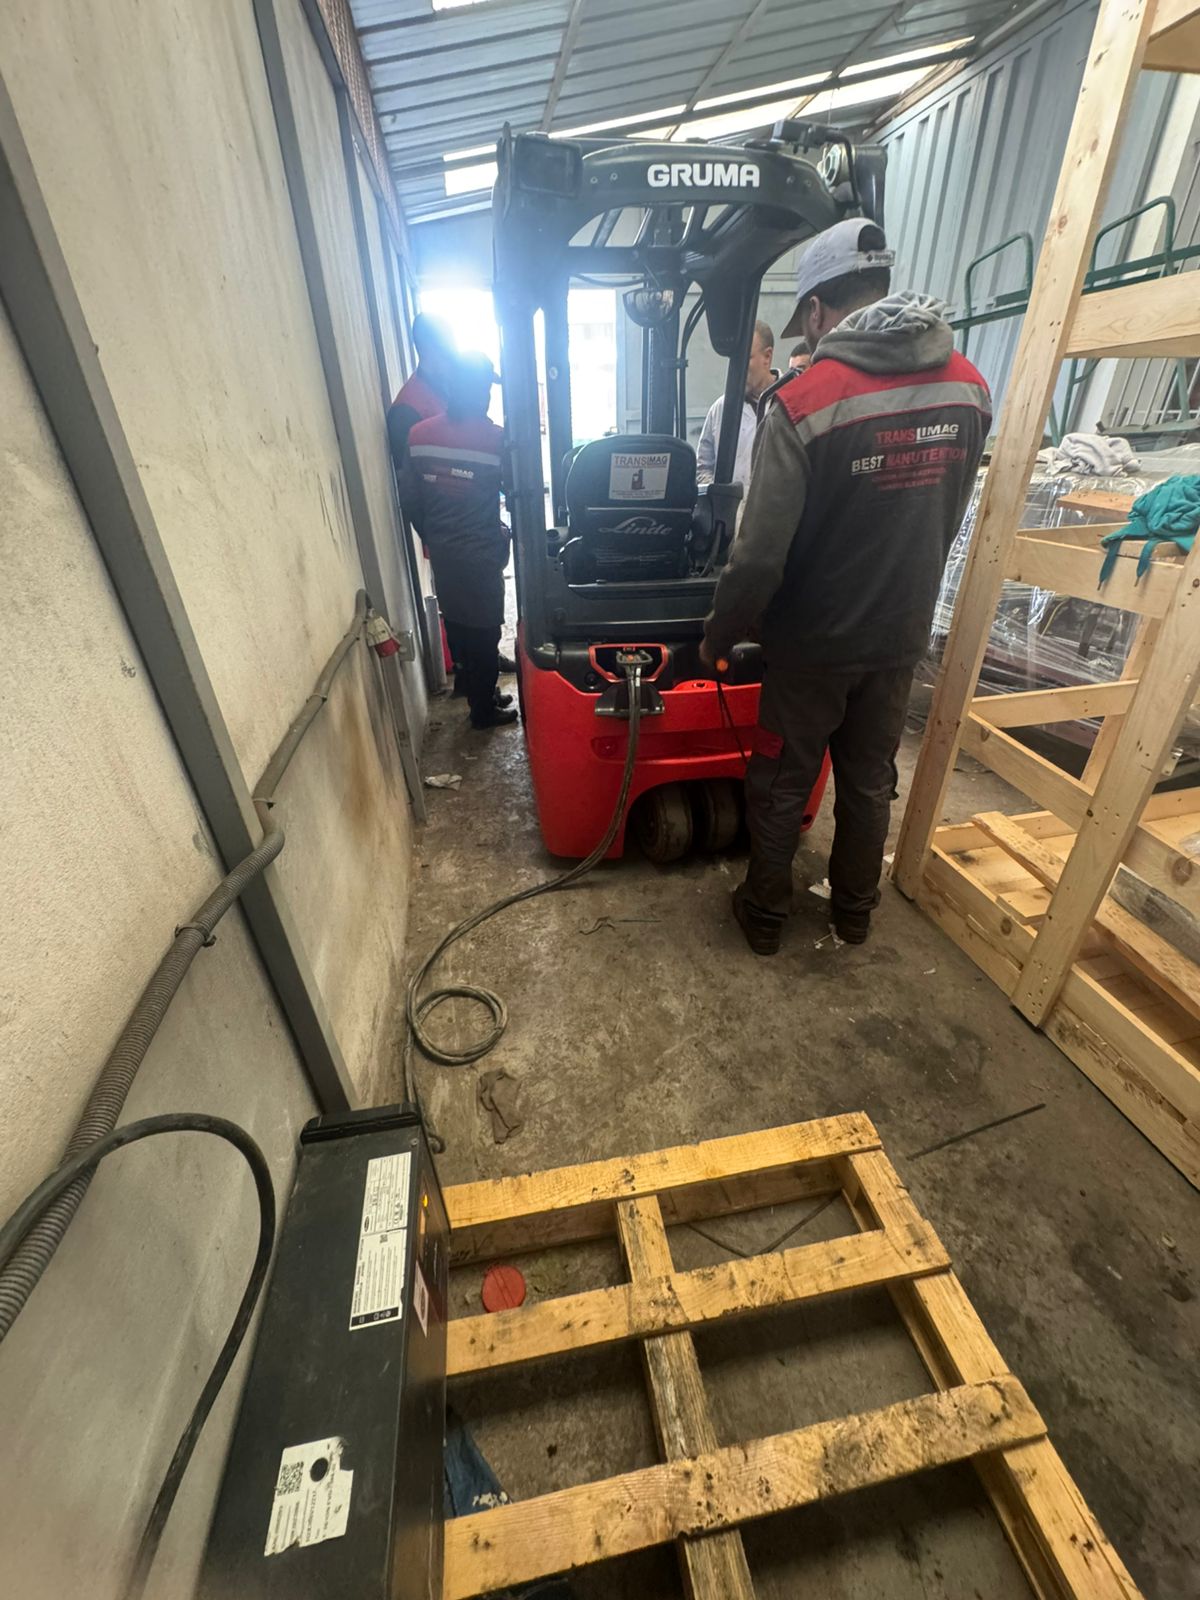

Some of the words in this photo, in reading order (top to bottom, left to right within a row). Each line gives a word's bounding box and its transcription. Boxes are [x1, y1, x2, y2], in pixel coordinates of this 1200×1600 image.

[647, 163, 760, 188] GRUMA
[851, 455, 884, 473] BEST
[597, 516, 672, 535] Linde
